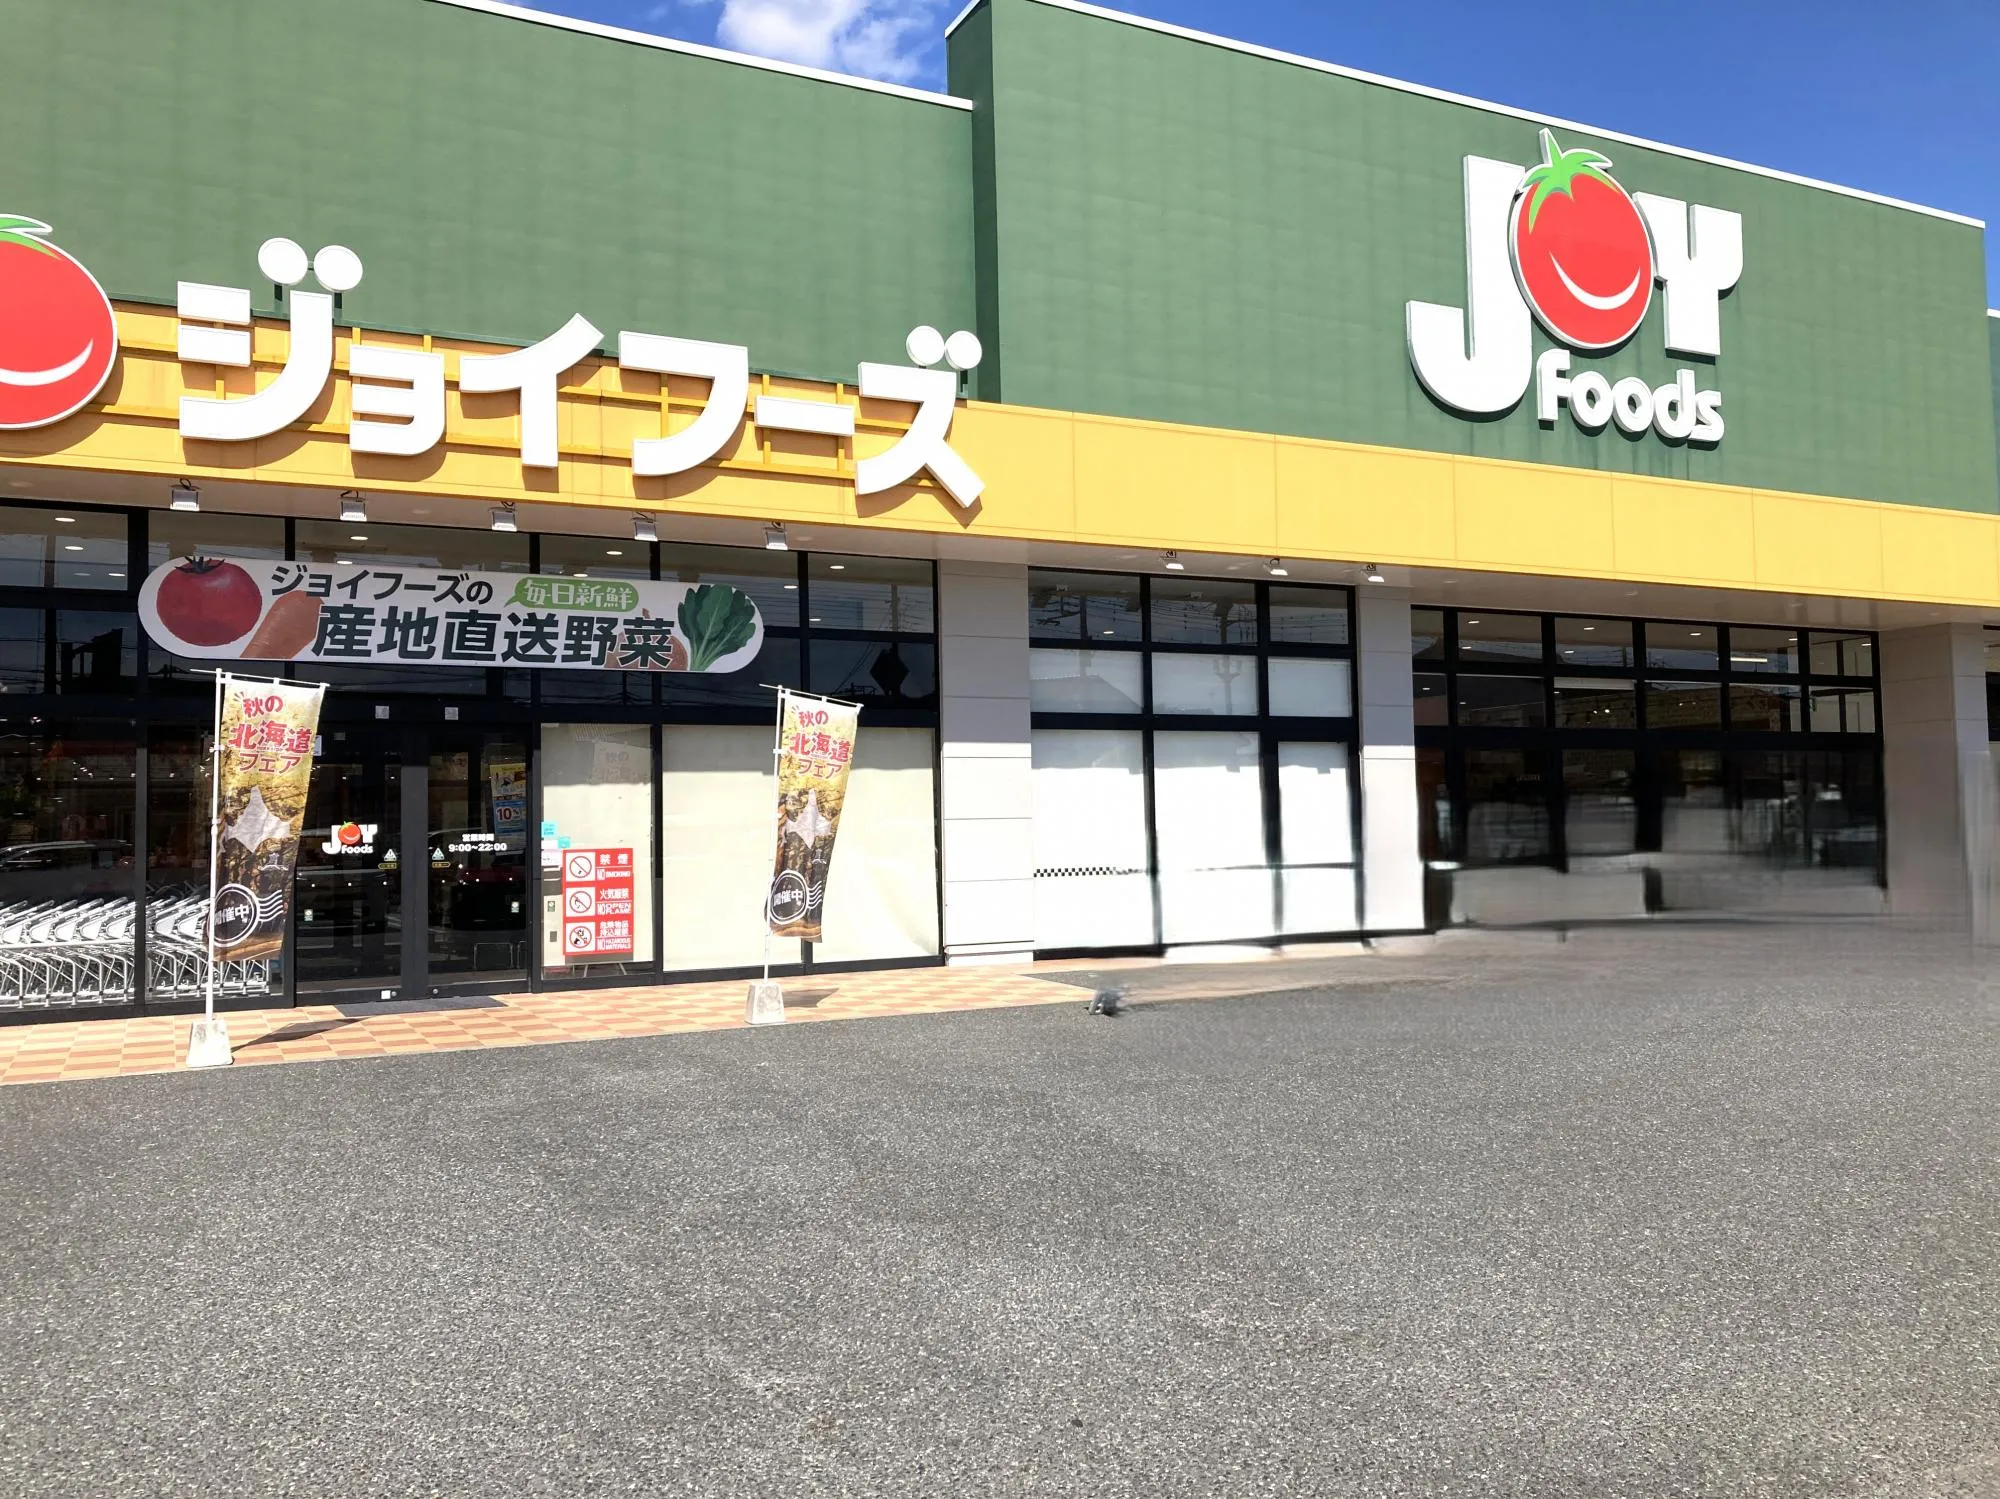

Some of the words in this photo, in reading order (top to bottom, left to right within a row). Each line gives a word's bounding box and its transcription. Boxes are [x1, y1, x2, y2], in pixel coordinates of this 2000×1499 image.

[177, 237, 985, 508] ジョイフーズ
[271, 564, 494, 606] ジョイフーズの
[523, 578, 634, 610] 毎日新鮮
[311, 603, 677, 669] 産地直送野菜
[243, 695, 284, 718] 秋の
[798, 710, 829, 728] 秋の
[228, 720, 312, 754] 北海道
[790, 732, 851, 763] 北海道
[239, 752, 302, 774] フェア
[798, 758, 842, 779] フェア
